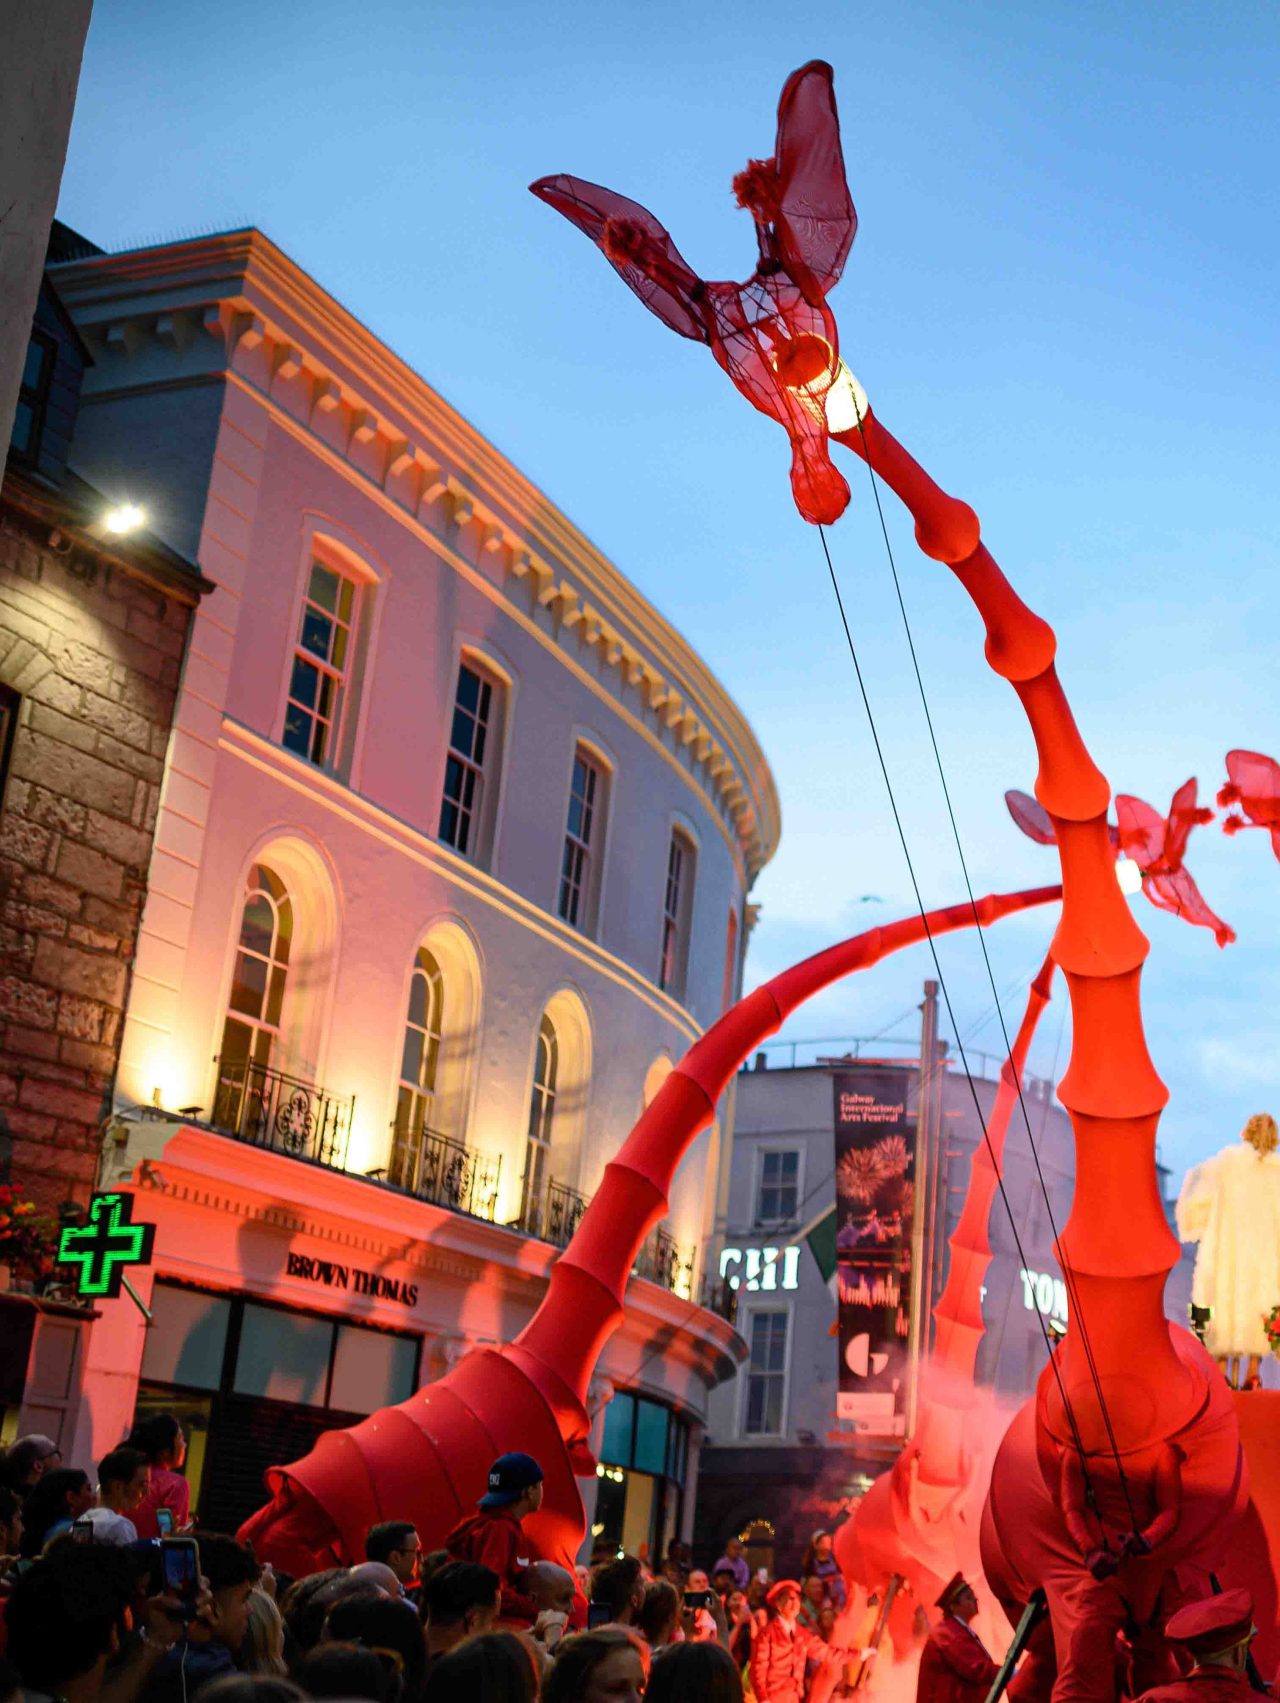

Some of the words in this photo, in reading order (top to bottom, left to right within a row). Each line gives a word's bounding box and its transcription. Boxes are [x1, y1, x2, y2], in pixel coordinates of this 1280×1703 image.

[840, 1092, 875, 1105] Galway
[840, 1103, 904, 1114] International
[840, 1113, 860, 1122] Arts
[862, 1113, 898, 1123] Festival
[286, 1252, 349, 1290] BROWN
[352, 1269, 419, 1308] THOMAS
